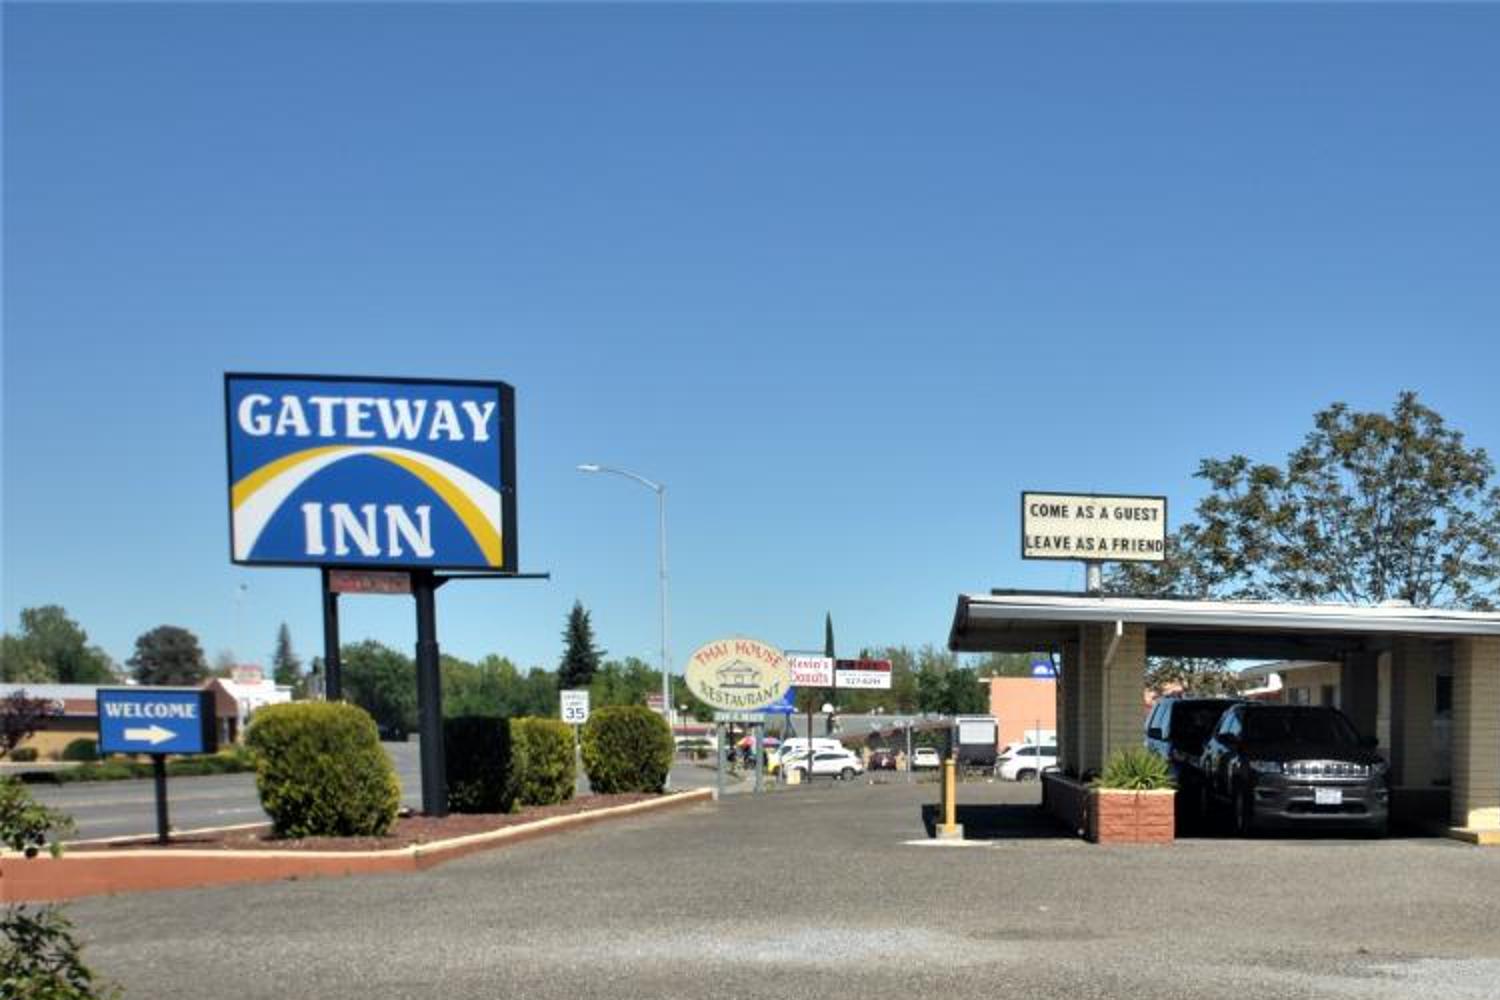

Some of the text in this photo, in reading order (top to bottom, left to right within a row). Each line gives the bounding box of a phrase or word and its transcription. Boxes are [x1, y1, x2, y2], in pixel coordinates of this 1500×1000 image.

[237, 393, 496, 442] GATEWAY
[1029, 503, 1159, 521] COME AS A GUEST
[301, 502, 435, 558] INN
[1025, 535, 1163, 552] LEAVE AS A FRIEND
[695, 640, 784, 668] THAI HOUSE
[104, 702, 198, 719] WELCOME
[565, 707, 585, 720] 35
